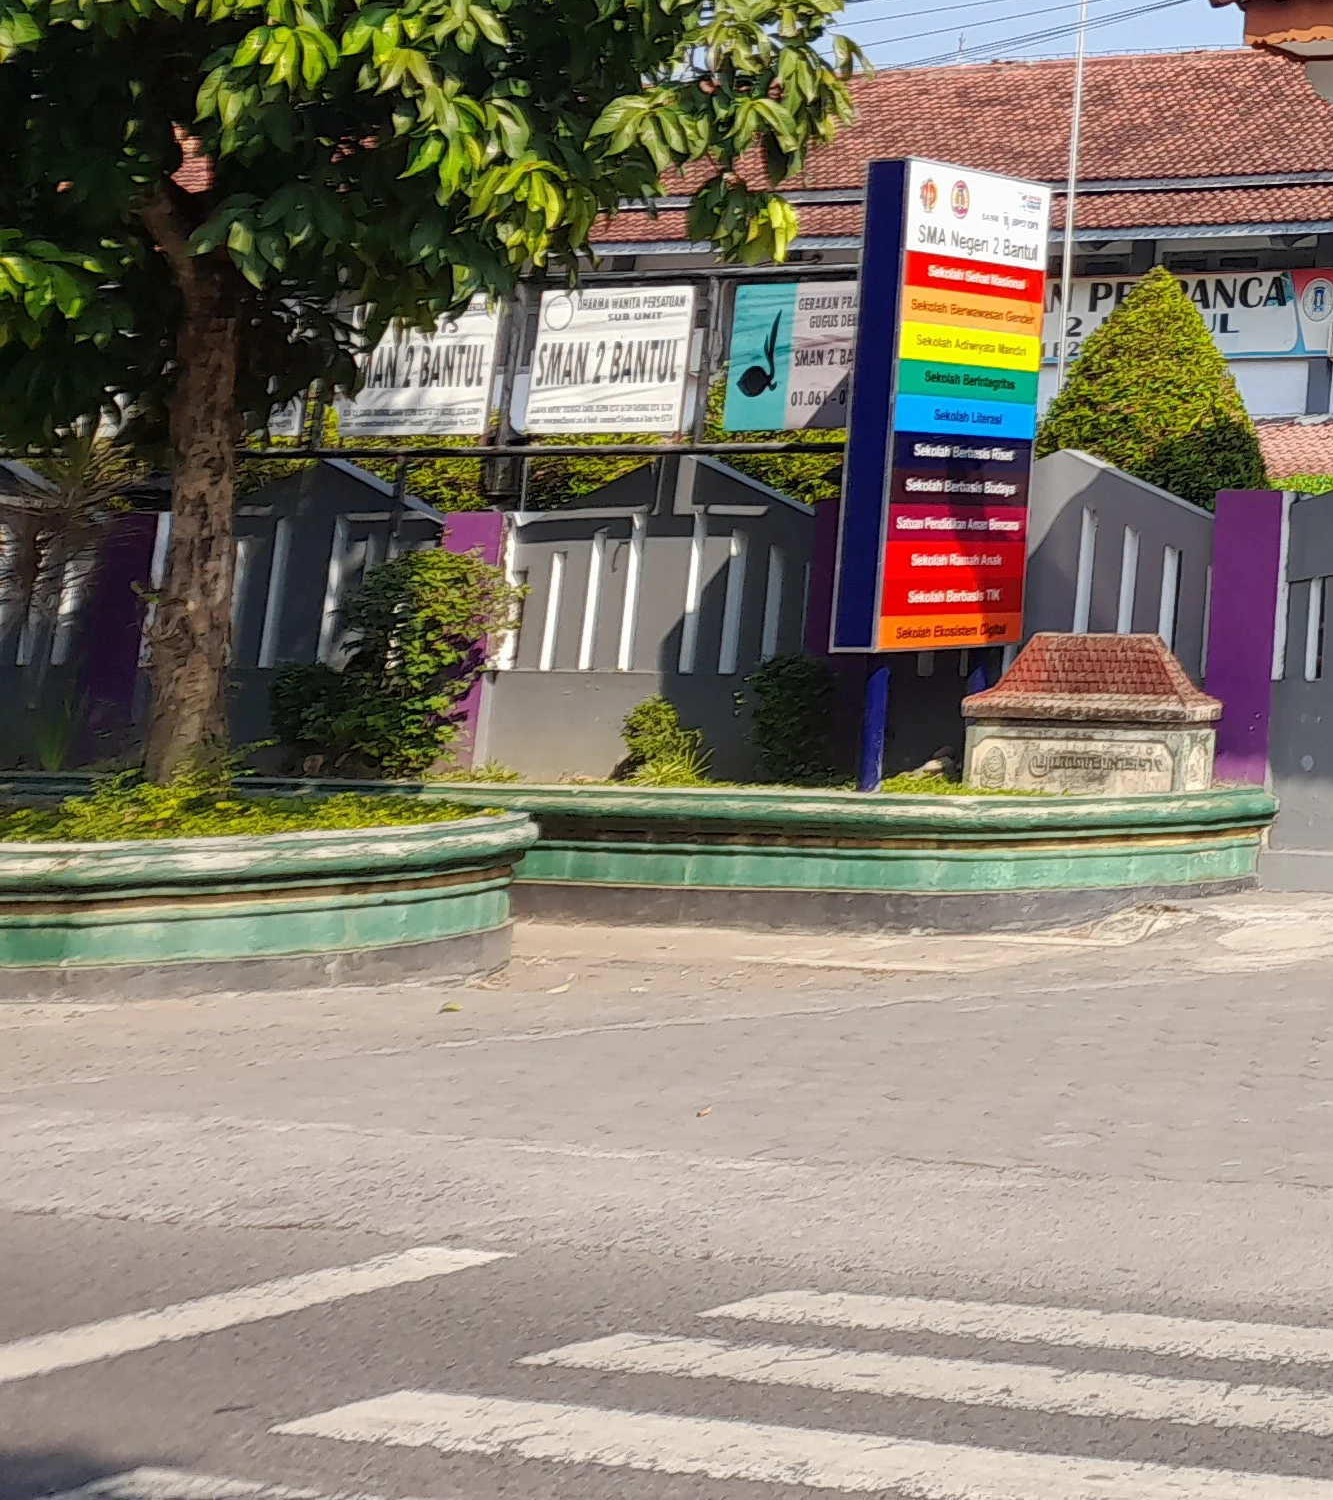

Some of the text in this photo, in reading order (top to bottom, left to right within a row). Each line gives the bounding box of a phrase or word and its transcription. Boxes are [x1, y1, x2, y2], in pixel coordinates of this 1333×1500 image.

[918, 224, 1039, 261] SMA Negeri 2 Bantul
[612, 296, 641, 310] WANITA
[643, 294, 688, 309] PERSATUAN
[798, 297, 839, 311] GERAKAN
[607, 311, 663, 322] SUB UNIT
[911, 298, 1035, 325] Sekolah Berwawasan Gender
[809, 314, 838, 329] GUGUS
[916, 334, 952, 349] Sekolah
[401, 344, 415, 389] 2
[418, 343, 485, 389] BANTUL
[535, 339, 678, 387] SMAN 2 BANTUL
[794, 350, 824, 367] SMAN
[828, 349, 835, 366] 2
[924, 370, 1016, 392] Sekolah Berintegritas
[934, 408, 1003, 426] Sekolah Literasi
[913, 442, 1015, 461] Sekolah Berbasis Riset
[905, 476, 1017, 497] Sekolah Berbasis Budaya
[911, 553, 1002, 567] Sekolah Ramah Anak
[907, 588, 1002, 604] Sekolah Berbasis TIK
[896, 625, 931, 640] Sekolah
[934, 624, 978, 638] Ekosistem
